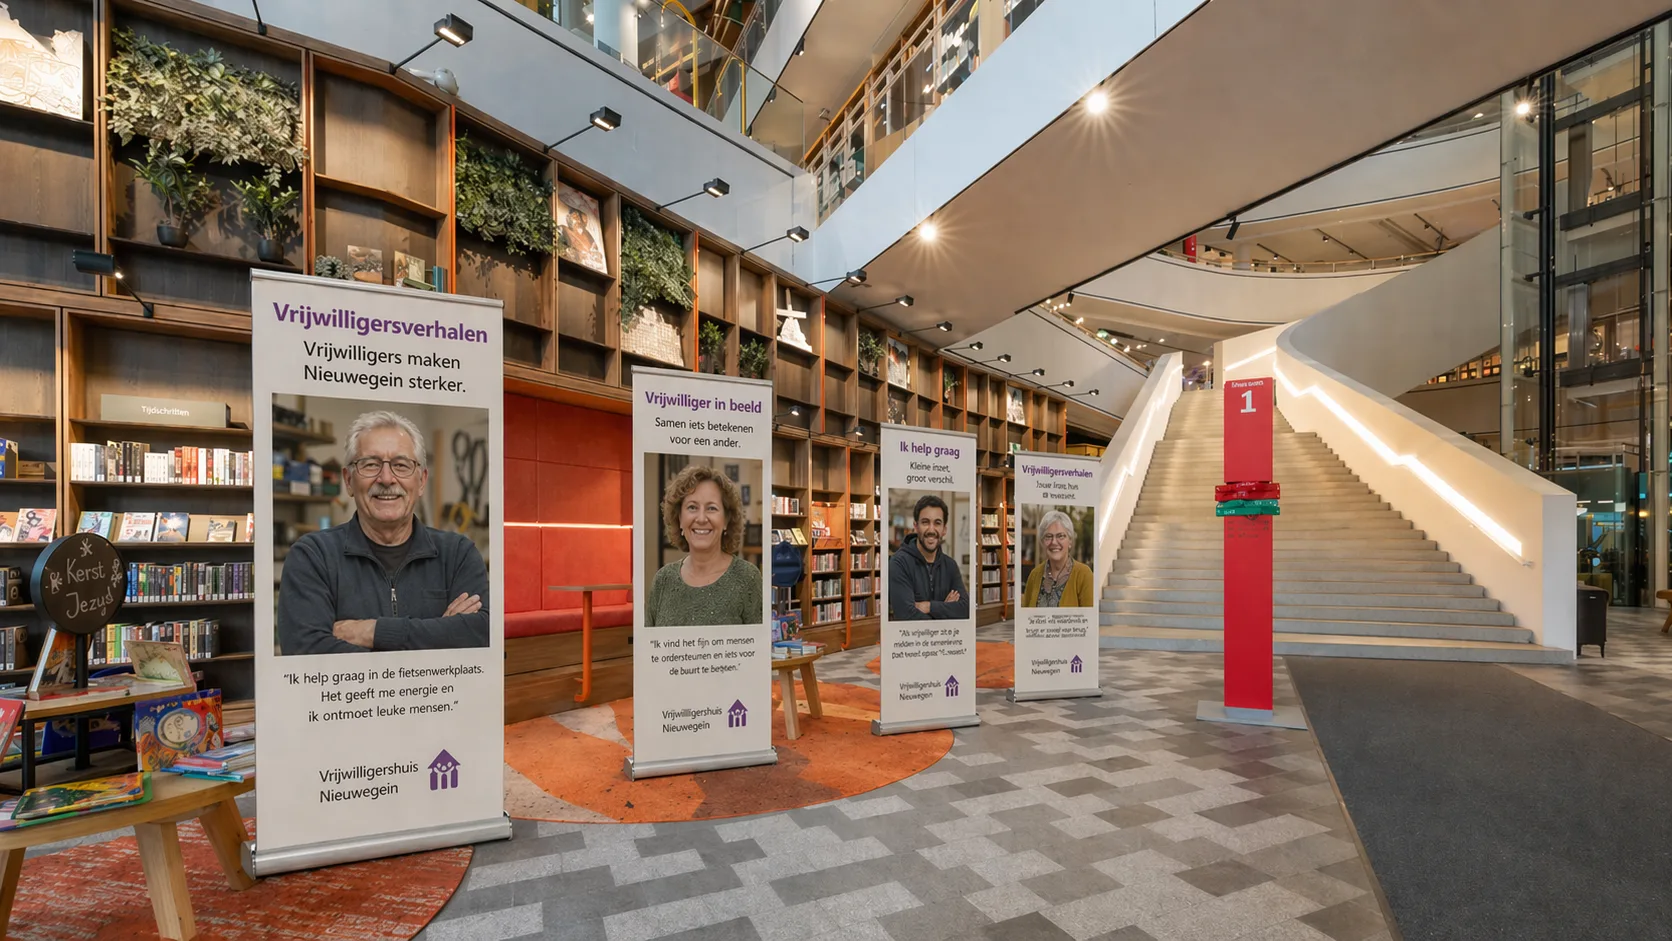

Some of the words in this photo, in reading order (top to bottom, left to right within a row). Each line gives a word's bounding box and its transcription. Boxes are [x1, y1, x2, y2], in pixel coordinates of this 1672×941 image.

[273, 302, 488, 344] Vrijwilligersverhalen
[303, 340, 402, 366] Vrijwilligers
[408, 352, 460, 369] maken
[304, 364, 403, 390] Nieuwegein
[408, 375, 466, 393] sterker.
[645, 391, 711, 411] Vrijwilliger
[714, 397, 726, 410] in
[730, 398, 762, 414] beeld
[1240, 389, 1257, 414] 1
[655, 417, 686, 429] Samen
[689, 419, 705, 430] iets
[707, 420, 754, 434] betekenen
[670, 436, 691, 445] voor
[694, 437, 711, 446] een
[713, 437, 741, 448] ander.
[900, 441, 909, 453] Ik
[911, 442, 932, 456] help
[934, 446, 960, 459] graag
[910, 461, 931, 471] Kleine
[1022, 464, 1093, 478] Vrijwilligersverhalen
[906, 474, 926, 485] groot
[66, 558, 106, 584] Kerst
[663, 639, 680, 648] vind
[682, 638, 696, 647] het
[698, 637, 710, 649] fijn
[726, 636, 755, 645] mensen
[651, 655, 659, 663] te
[724, 650, 738, 659] iets
[738, 649, 756, 658] voor
[303, 671, 329, 686] help
[332, 671, 365, 686] graag
[368, 668, 379, 680] in
[382, 667, 396, 679] de
[398, 664, 484, 679] fietsenwerkplaats.
[669, 667, 679, 676] de
[680, 666, 700, 675] buurt
[701, 666, 710, 674] te
[321, 690, 342, 703] Het
[345, 687, 375, 704] geeft
[378, 688, 396, 699] me
[399, 683, 438, 698] energie
[441, 684, 454, 694] en
[308, 710, 319, 722] ik
[323, 707, 373, 721] ontmoet
[376, 705, 406, 717] leuke
[409, 700, 459, 715] mensen.”
[662, 721, 710, 733] Nieuwegein
[319, 761, 419, 784] Vrijwilligershuis
[319, 783, 399, 803] Nieuwegein
